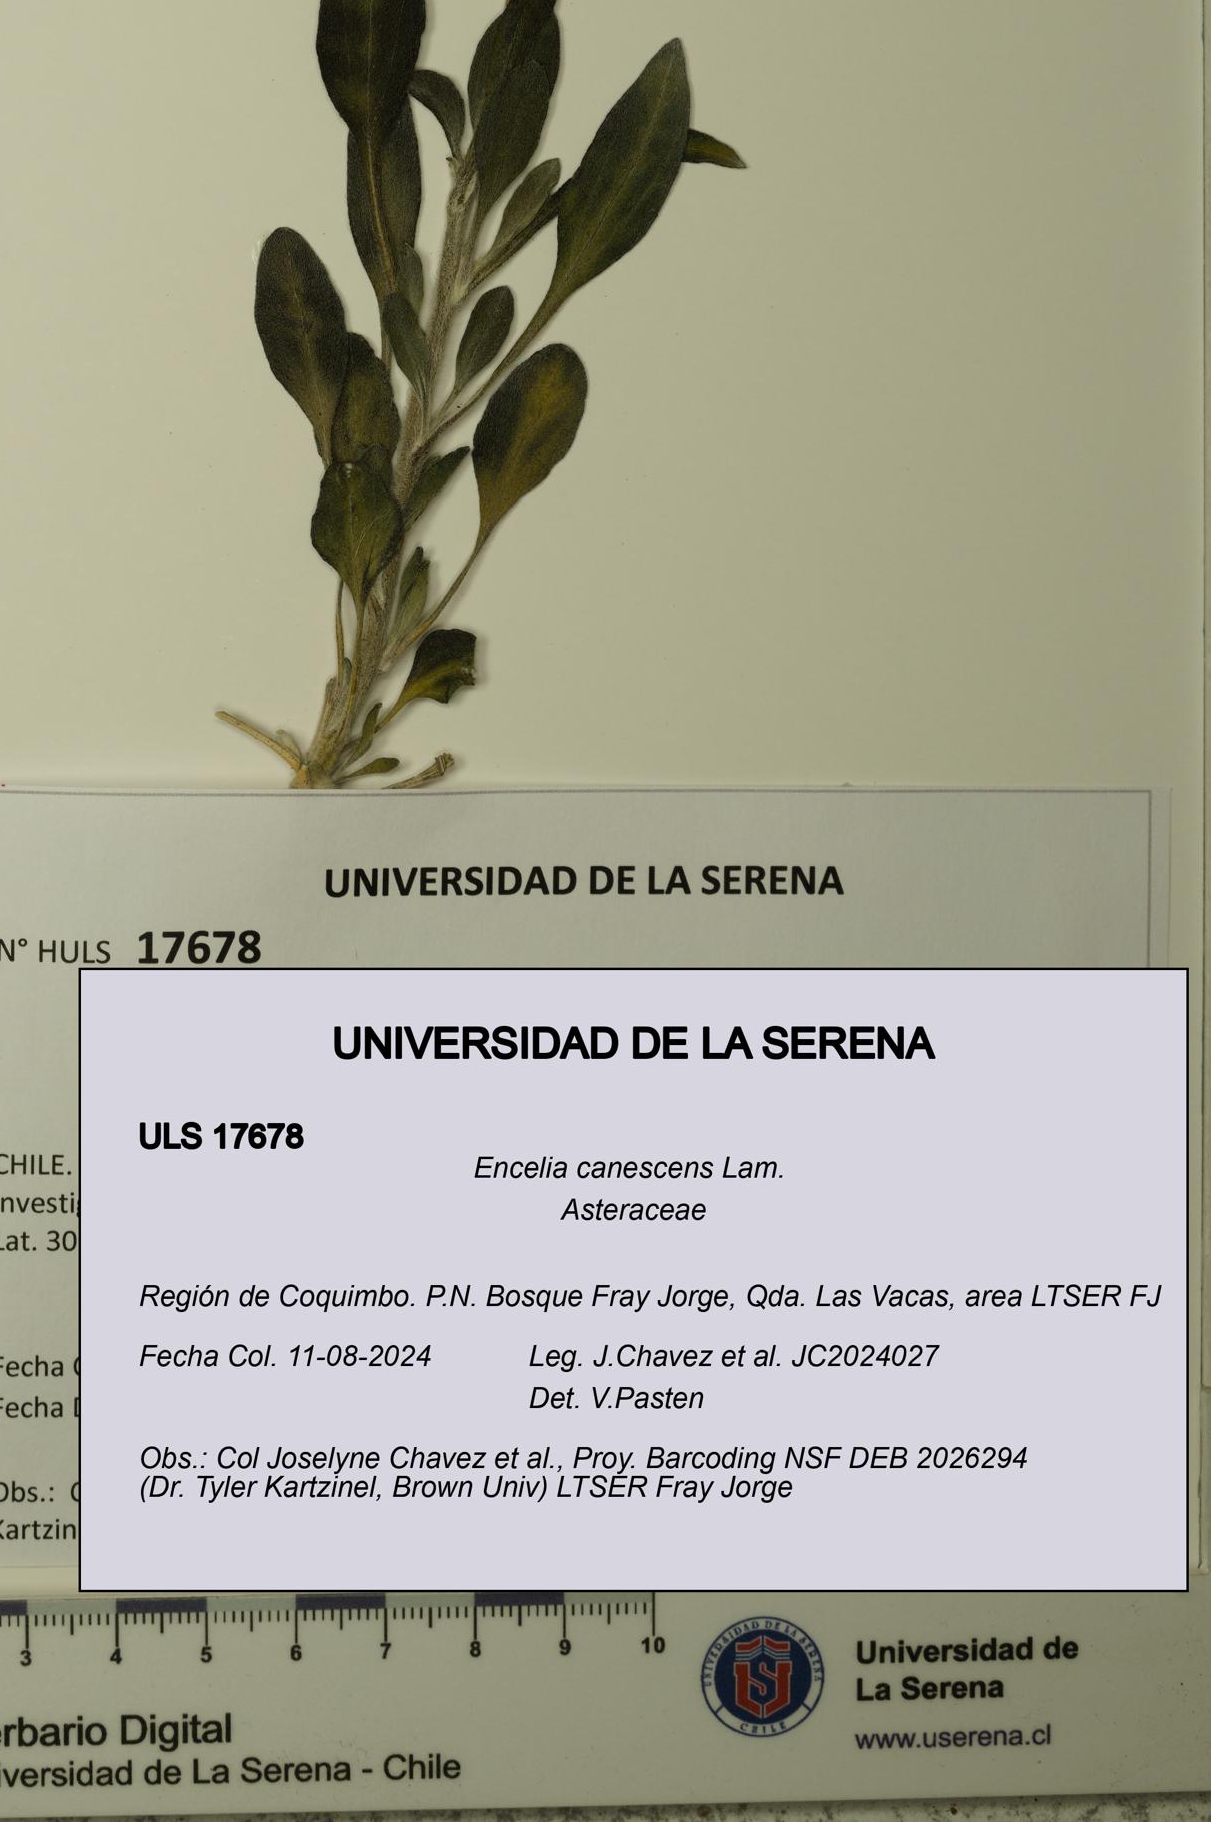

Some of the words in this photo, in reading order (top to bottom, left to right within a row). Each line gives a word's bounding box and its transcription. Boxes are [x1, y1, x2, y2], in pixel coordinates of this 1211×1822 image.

[325, 865, 577, 899] UNIVERSIDAD
[589, 865, 636, 895] DE
[648, 865, 692, 895] LA
[701, 864, 845, 896] SERENA
[38, 939, 111, 965] HULS
[138, 929, 262, 965] 17678
[20, 1649, 33, 1666] 3
[109, 1647, 123, 1665] 4
[200, 1645, 213, 1663] 5
[290, 1644, 303, 1661] 6
[379, 1642, 392, 1660] 7
[469, 1640, 482, 1658] 8
[558, 1638, 572, 1656] 9
[641, 1636, 666, 1654] 10
[856, 1635, 1034, 1665] Universidad
[1042, 1635, 1079, 1661] de
[856, 1677, 892, 1702] La
[900, 1675, 1005, 1701] Serena
[120, 1712, 232, 1753] Digital
[854, 1723, 1052, 1750] www.userena.cl
[143, 1758, 182, 1786] de
[192, 1757, 230, 1785] La
[240, 1756, 352, 1784] Serena
[383, 1752, 462, 1781] Chile
